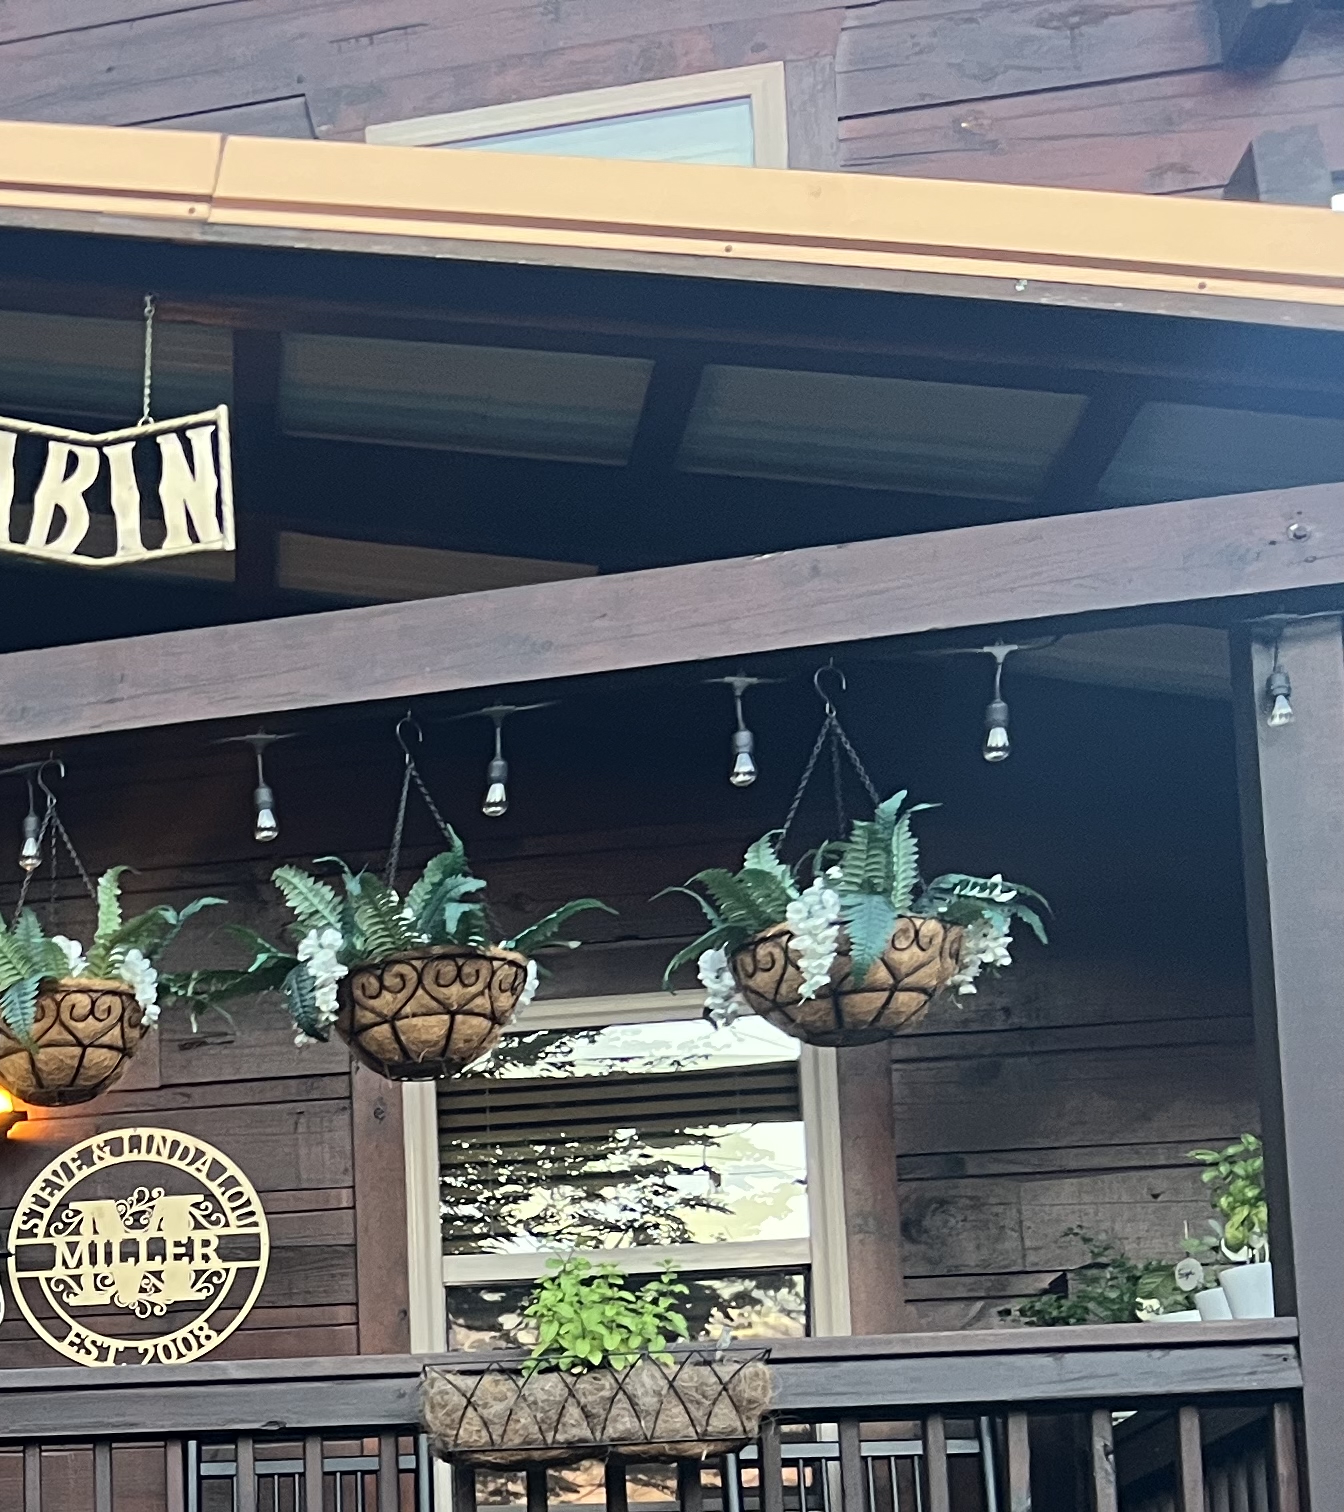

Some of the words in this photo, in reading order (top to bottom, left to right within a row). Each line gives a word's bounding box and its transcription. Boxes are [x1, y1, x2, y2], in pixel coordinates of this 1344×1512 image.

[19, 1153, 89, 1237] STEVE
[122, 1133, 213, 1174] LINDA
[216, 1168, 257, 1230] LOU
[54, 1234, 223, 1270] MILLER
[137, 1321, 218, 1366] 2008
